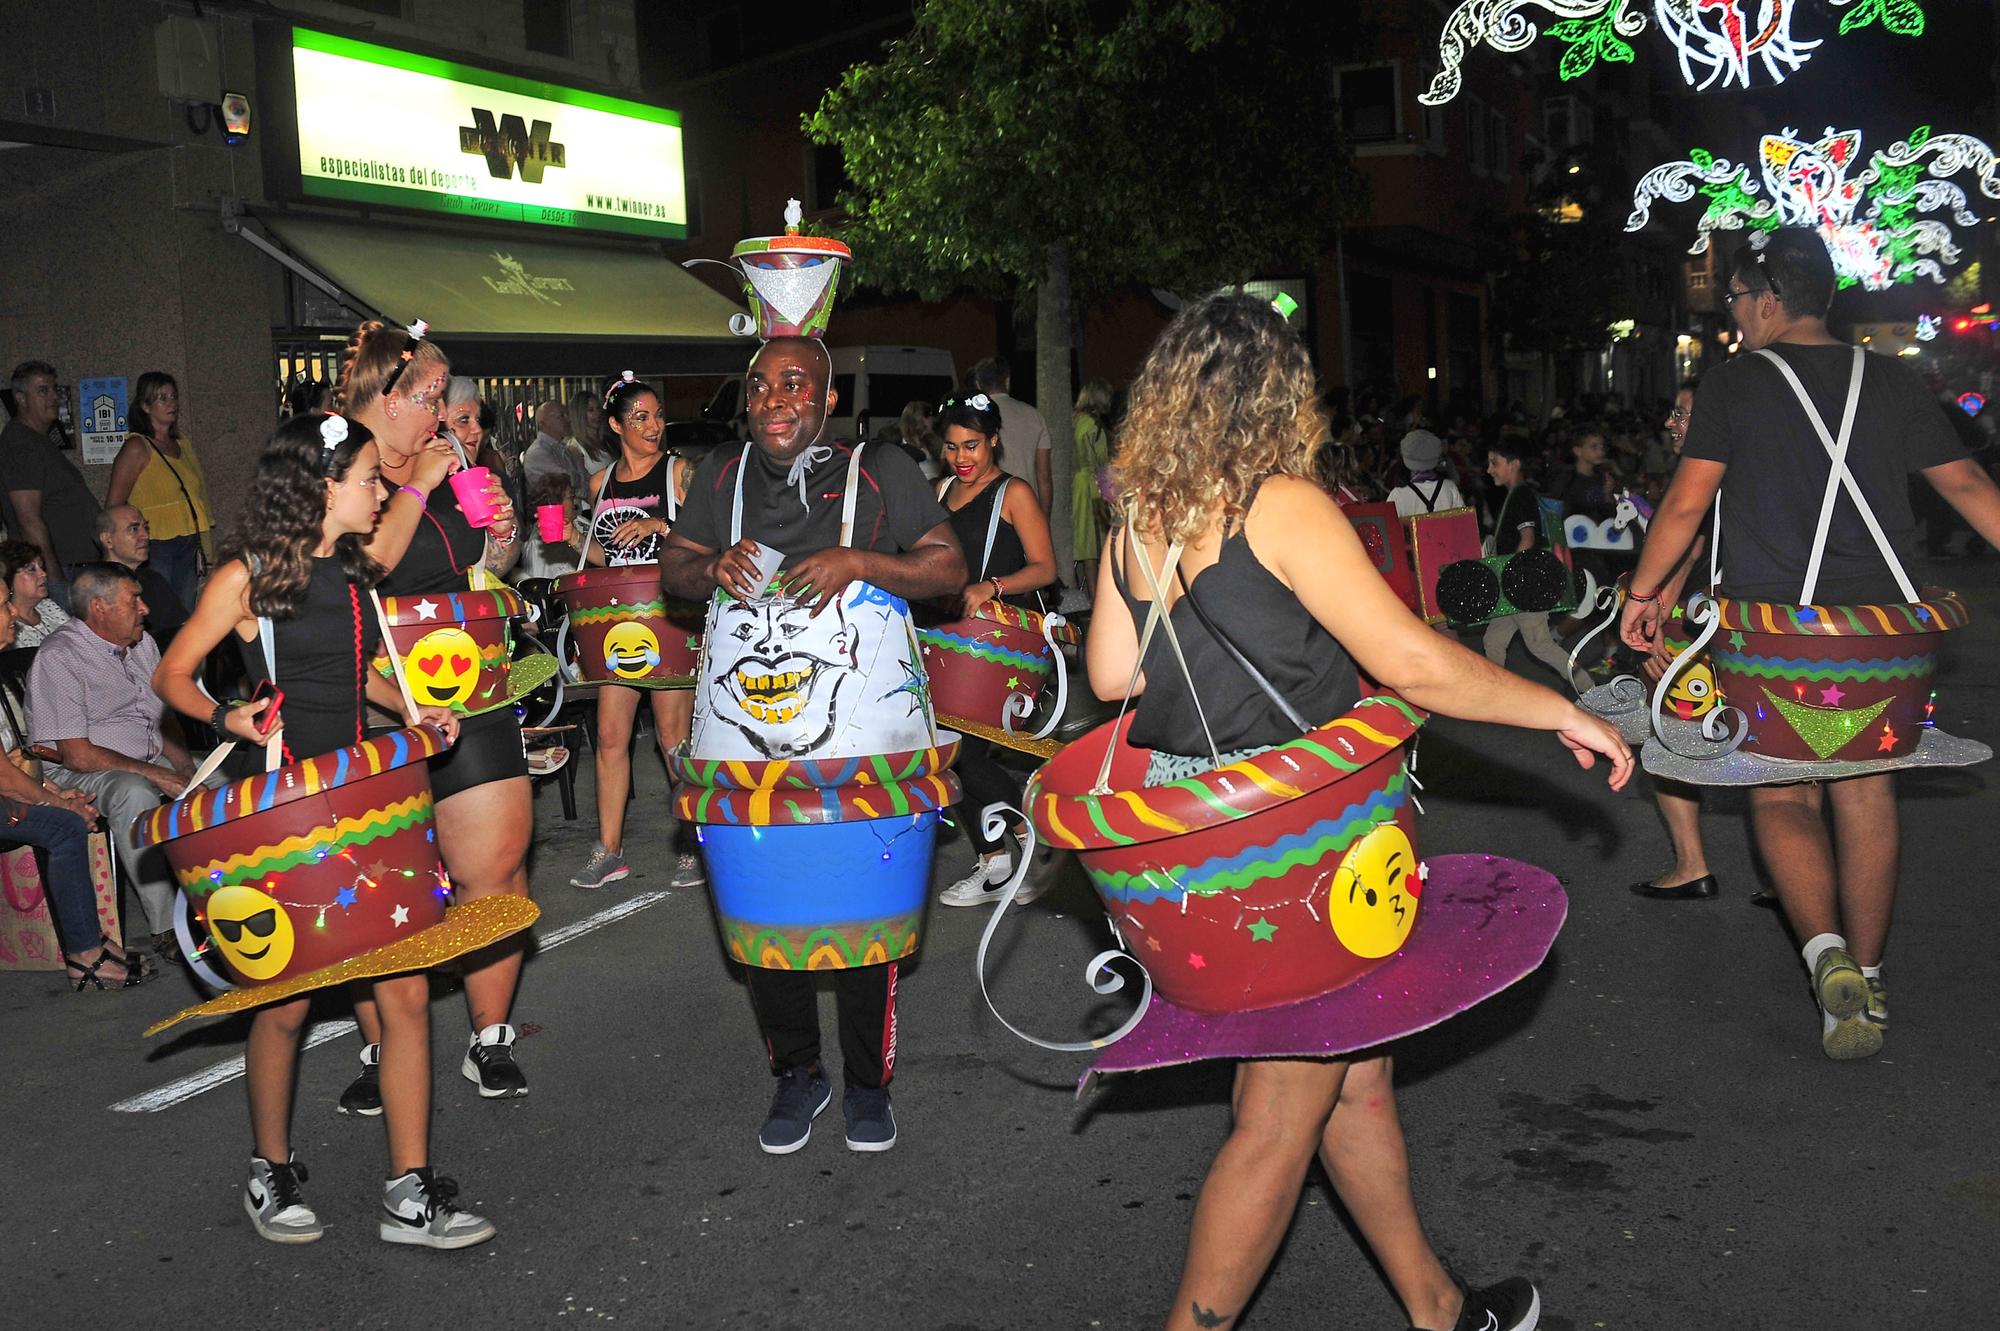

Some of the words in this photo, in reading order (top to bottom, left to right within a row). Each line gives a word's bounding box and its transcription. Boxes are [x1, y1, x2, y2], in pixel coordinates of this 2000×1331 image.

[320, 156, 405, 183] especialistas
[410, 165, 428, 186] del
[431, 168, 477, 191] deporte
[541, 209, 566, 223] DESDE
[98, 409, 111, 419] IBI
